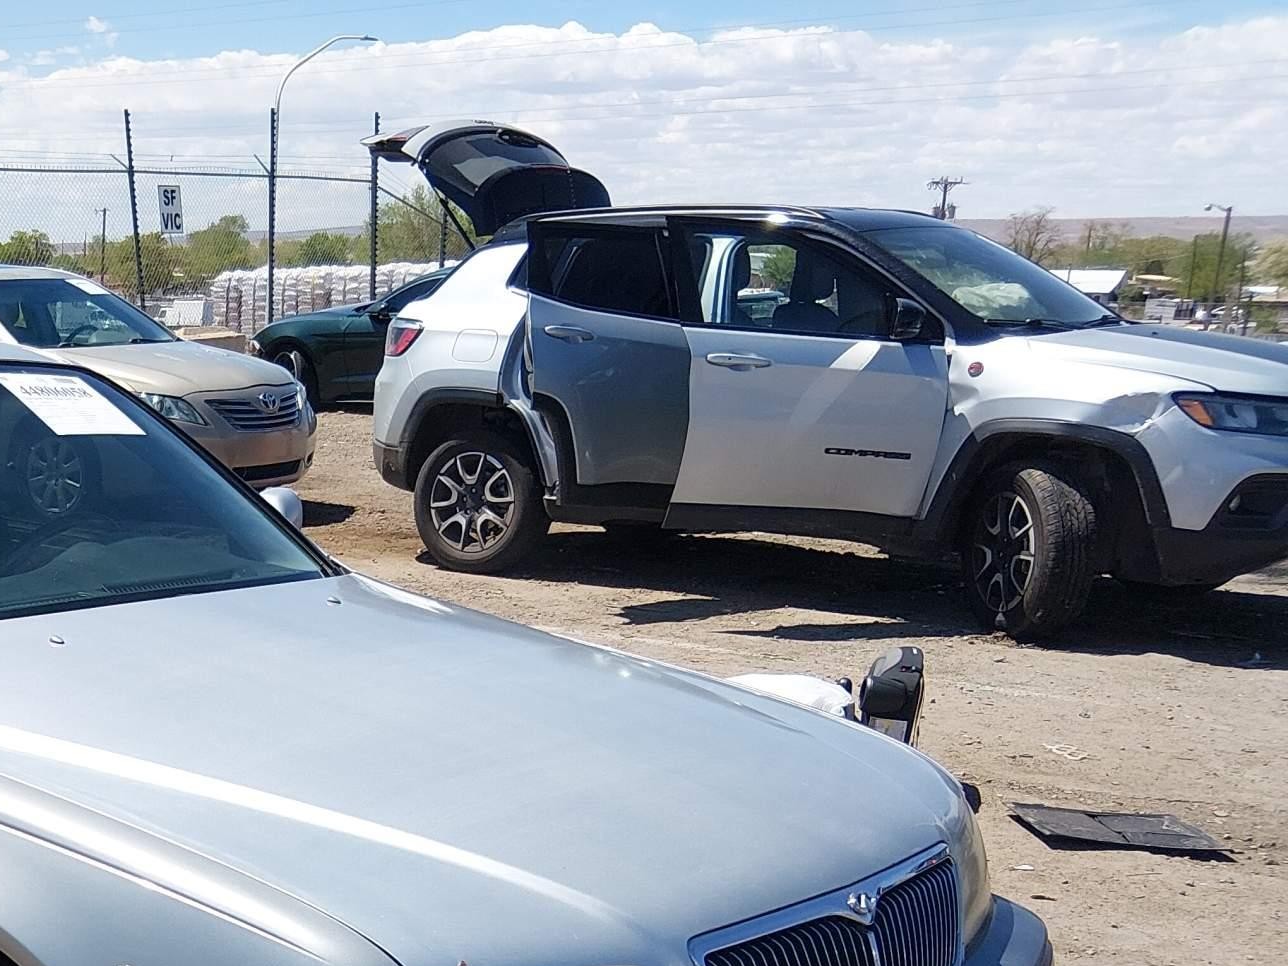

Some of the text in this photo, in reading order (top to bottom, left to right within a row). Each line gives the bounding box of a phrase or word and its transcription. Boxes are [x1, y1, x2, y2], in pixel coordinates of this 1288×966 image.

[163, 189, 176, 206] SF
[162, 213, 181, 230] VIC
[824, 447, 912, 460] COMPASS
